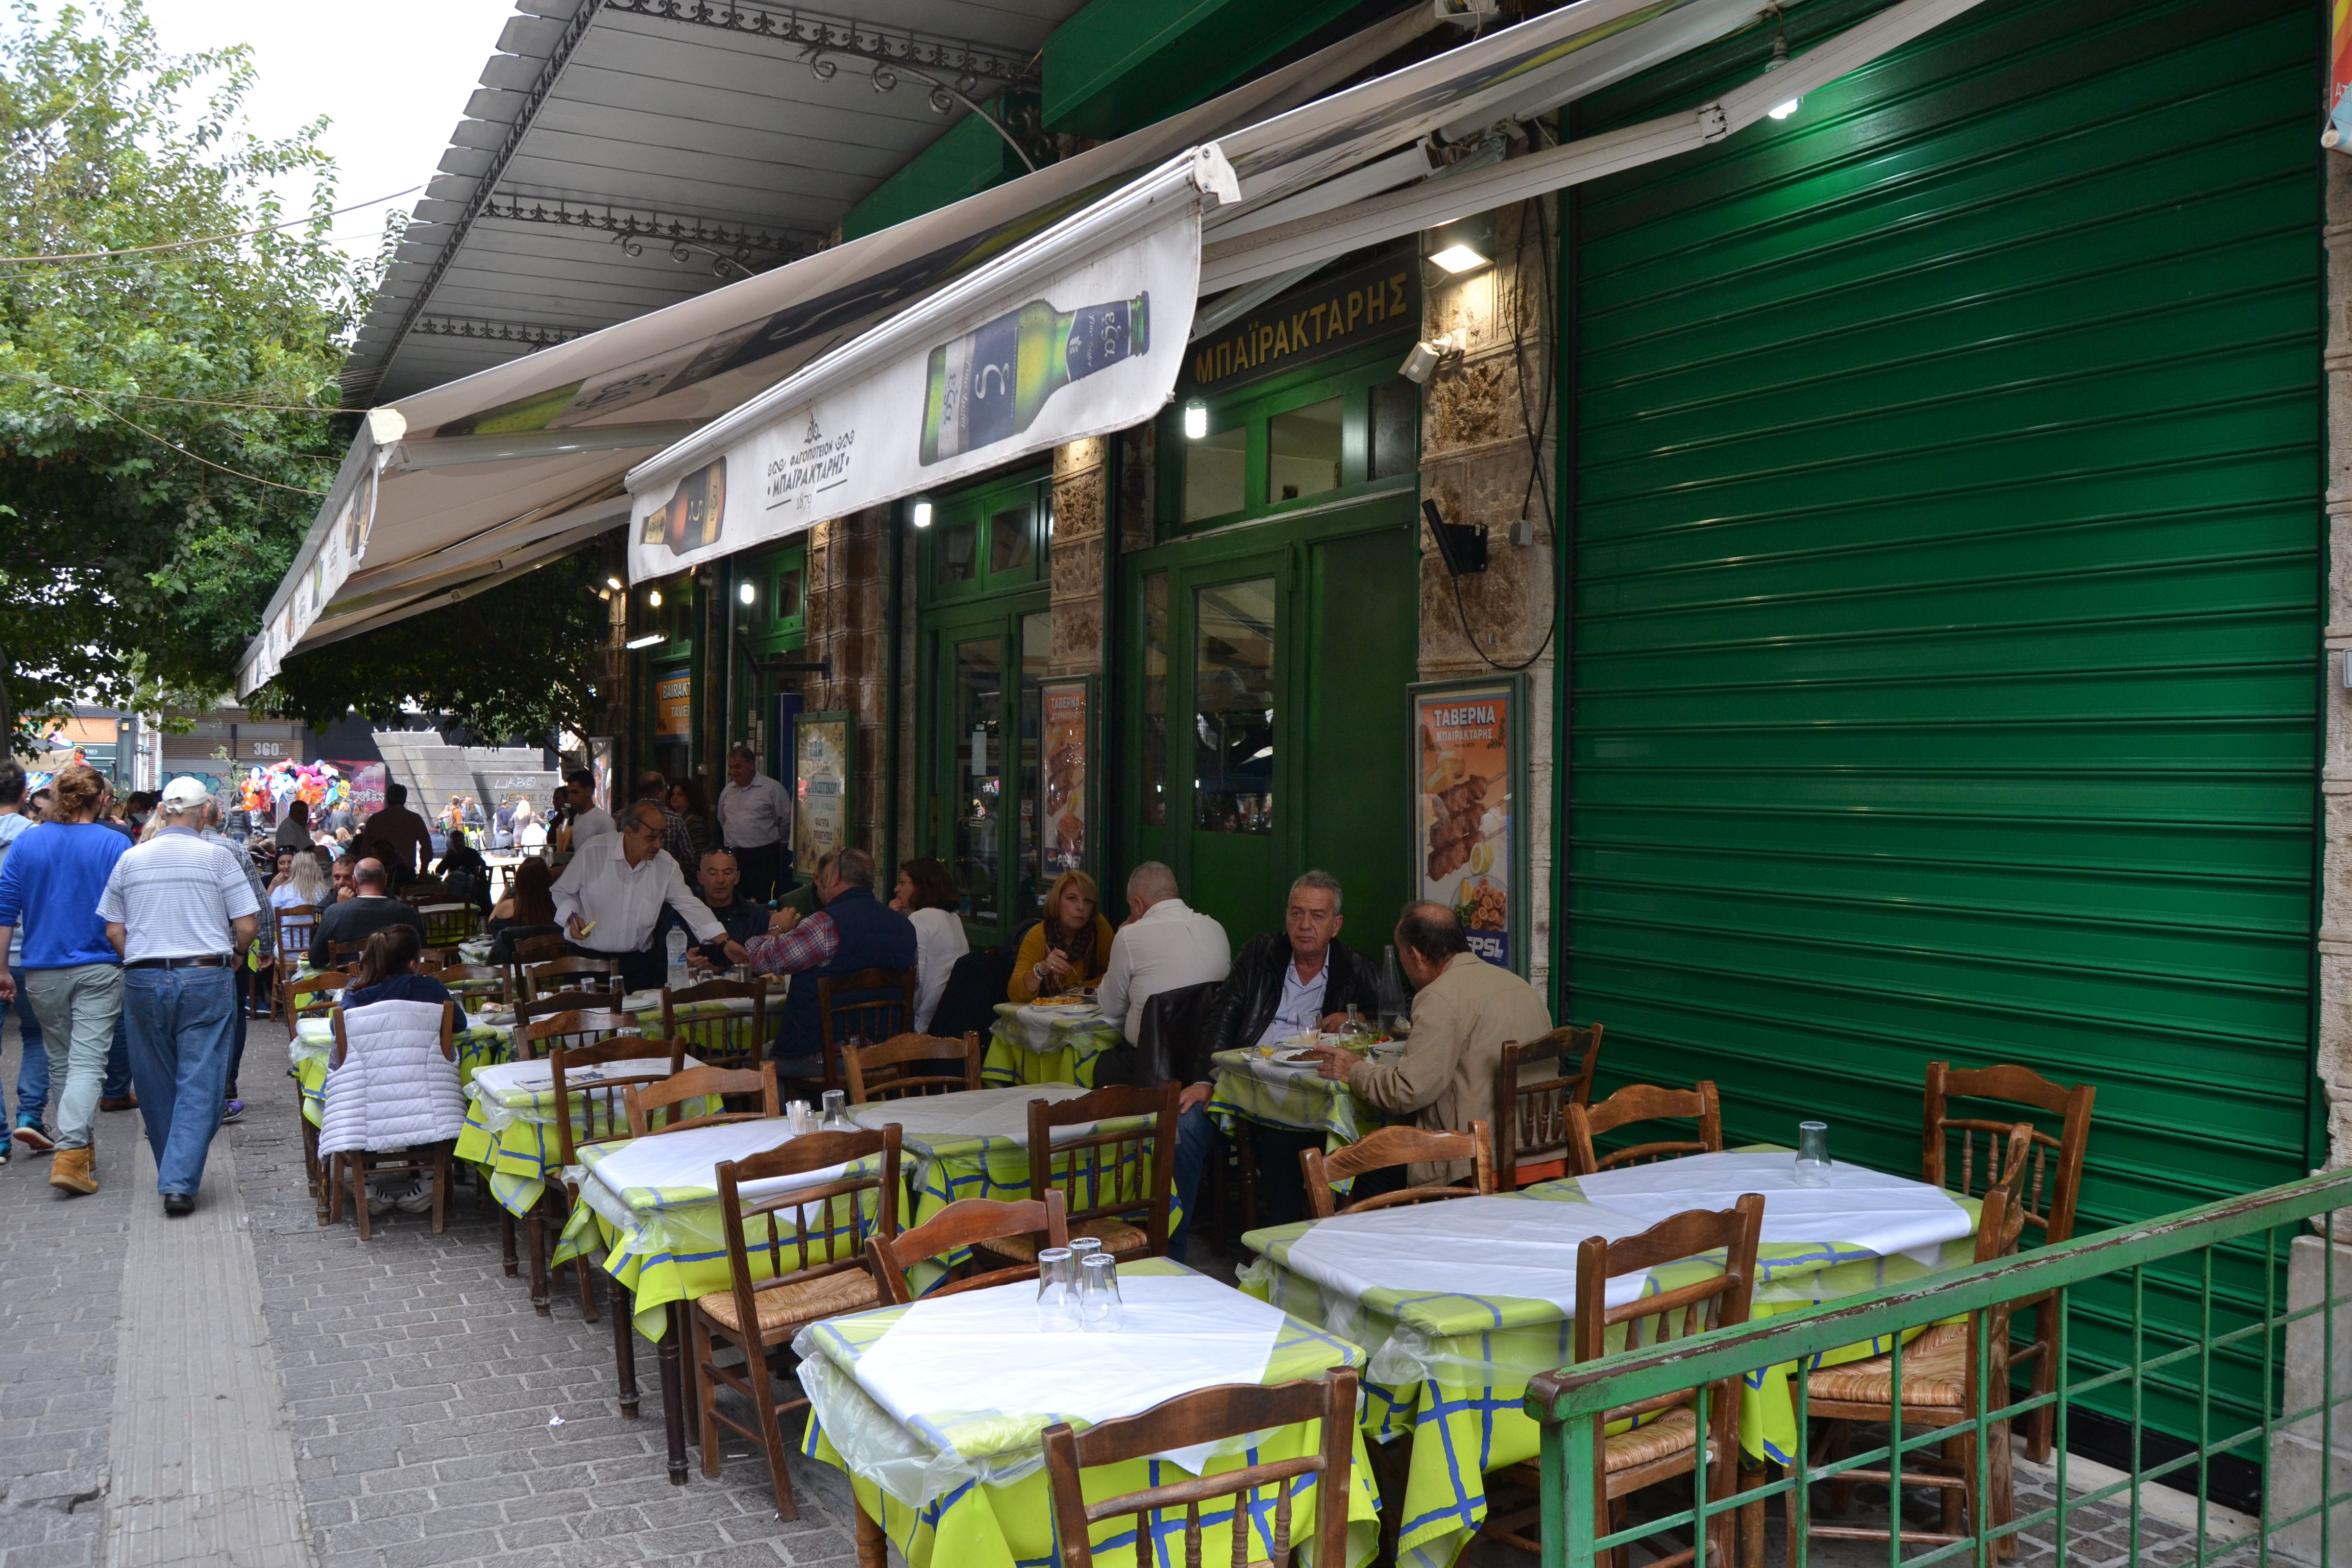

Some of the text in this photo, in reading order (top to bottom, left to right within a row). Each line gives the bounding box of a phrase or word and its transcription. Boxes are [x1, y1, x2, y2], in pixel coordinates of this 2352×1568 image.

[1195, 272, 1407, 384] ΜΠΑΪΡΑΚΤΑΡΗΣ
[790, 439, 833, 467] ΦΑΓΟΠΟΤΕΙΟΝ
[772, 452, 845, 497] ΜΠΑΪΡΑΚΤΑΡΗΣ
[796, 492, 812, 510] 1879
[1051, 696, 1080, 709] ΤΑΒΕΡΝΑ
[1434, 706, 1496, 727] ΤΑΒΕΡΝΑ
[254, 742, 279, 756] 360
